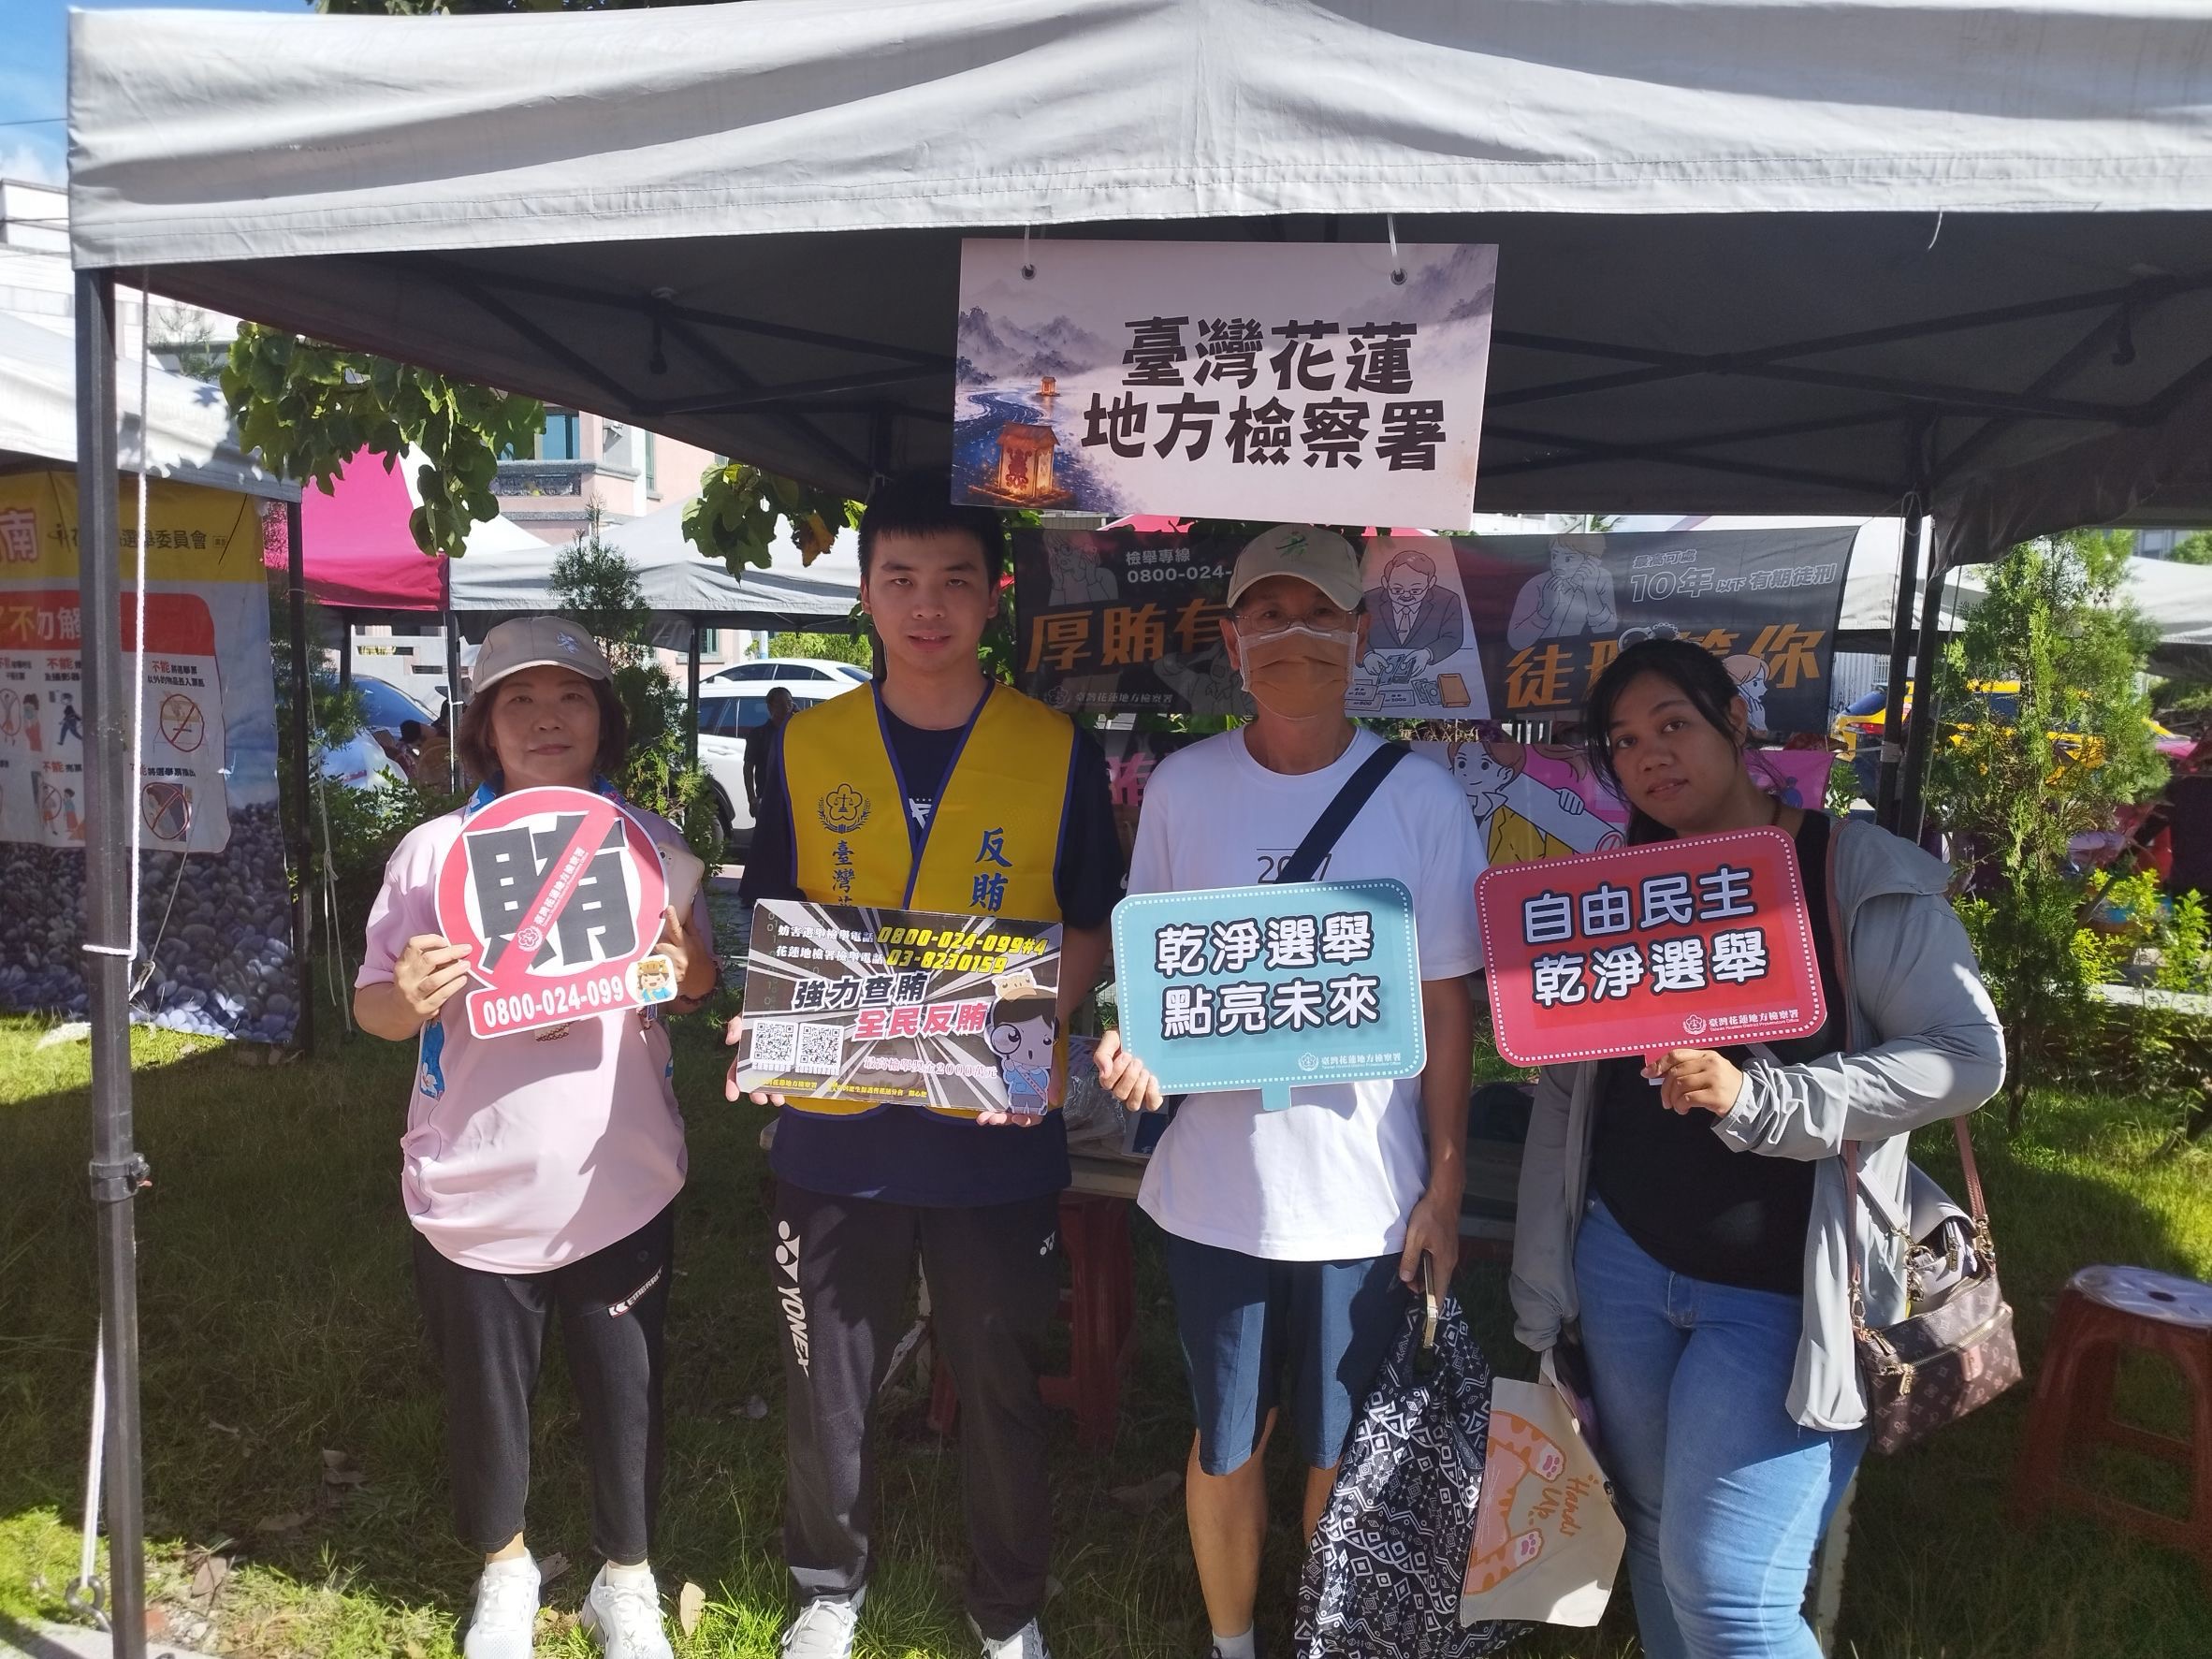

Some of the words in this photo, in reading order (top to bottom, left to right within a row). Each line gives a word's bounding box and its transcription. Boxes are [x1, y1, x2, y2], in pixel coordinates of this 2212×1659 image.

[1122, 316, 1417, 393] 臺灣花蓮
[1081, 391, 1447, 471] 地方檢察署
[1126, 548, 1190, 566] 檢舉專線
[1521, 863, 1758, 946] 自由民主
[877, 926, 1048, 956] 0800-024-099#4
[886, 949, 1009, 974] 03-8230159
[1156, 910, 1375, 977] 乾淨選舉
[1530, 925, 1768, 1009] 乾淨選舉
[483, 976, 625, 1028] 0800-024-099
[792, 970, 932, 1012] 強力查賄
[851, 1000, 993, 1042] 全民反賄
[1160, 972, 1382, 1041] 點亮未來
[778, 1286, 809, 1378] YONEX
